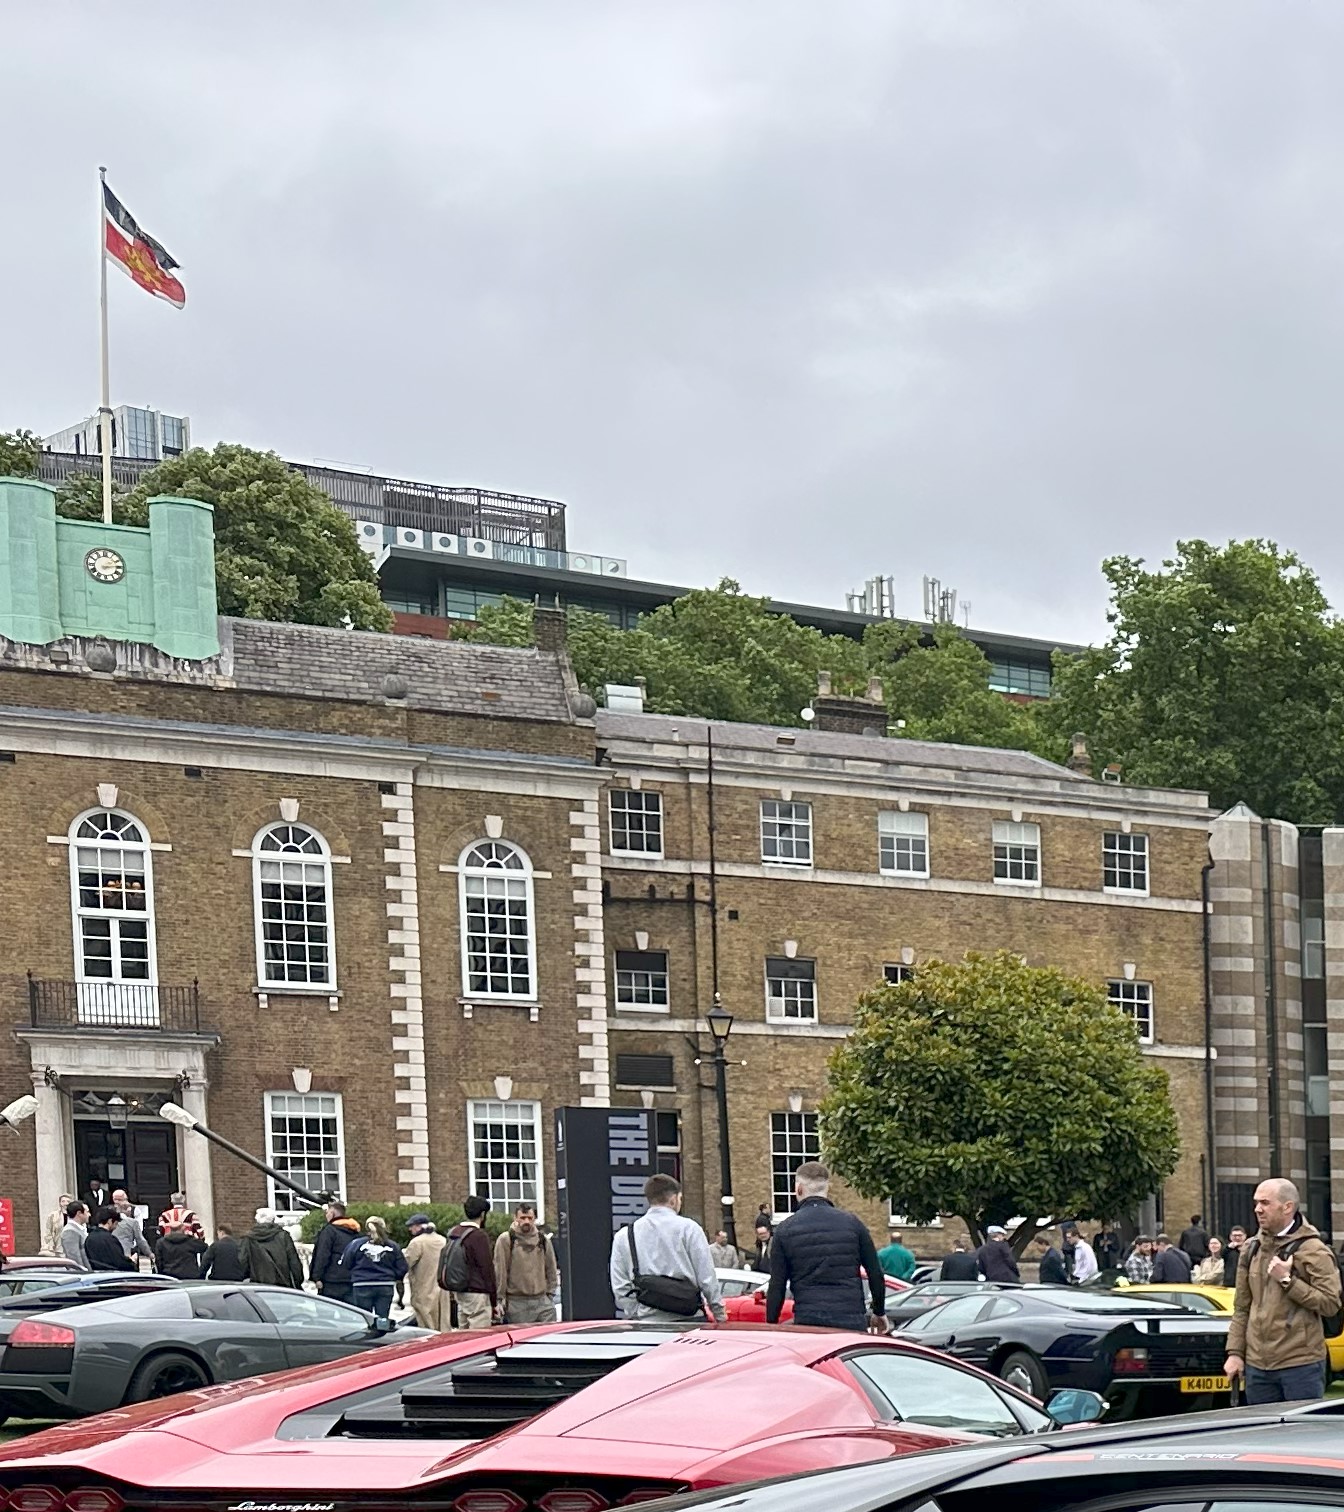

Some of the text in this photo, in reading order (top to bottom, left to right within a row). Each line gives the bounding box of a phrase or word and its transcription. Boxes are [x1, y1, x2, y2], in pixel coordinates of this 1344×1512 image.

[608, 1113, 650, 1231] THE DRE
[1187, 1378, 1231, 1390] K410 UJ
[228, 1501, 335, 1512] Lamborghini
